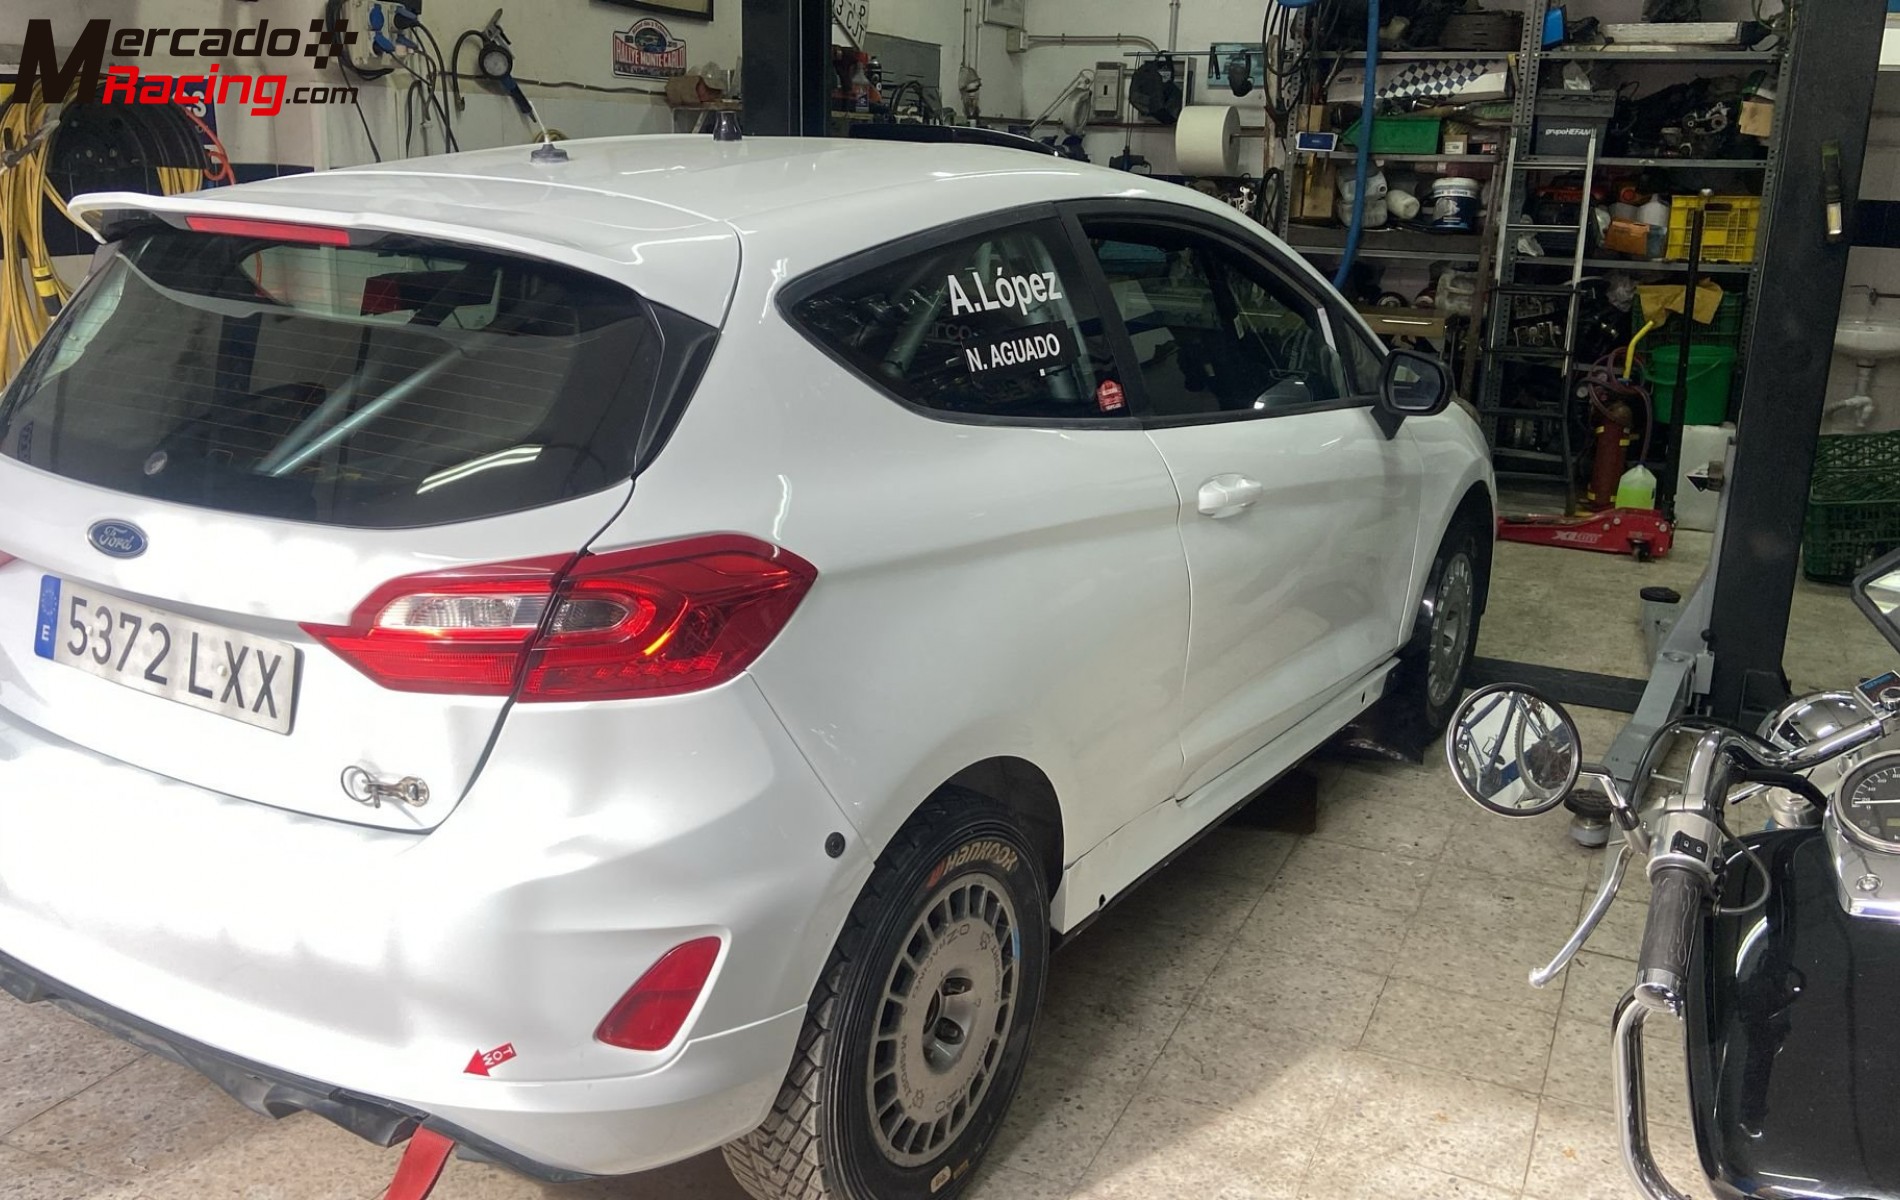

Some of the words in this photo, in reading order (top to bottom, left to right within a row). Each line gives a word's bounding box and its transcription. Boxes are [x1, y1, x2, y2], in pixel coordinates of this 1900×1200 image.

[947, 267, 1062, 316] A.López
[966, 347, 988, 372] N.
[991, 333, 1060, 368] AGUADO
[99, 525, 135, 550] Ford
[41, 625, 50, 641] E
[67, 596, 171, 686] 5372
[188, 631, 282, 719] LXX
[482, 1046, 513, 1066] TOW
